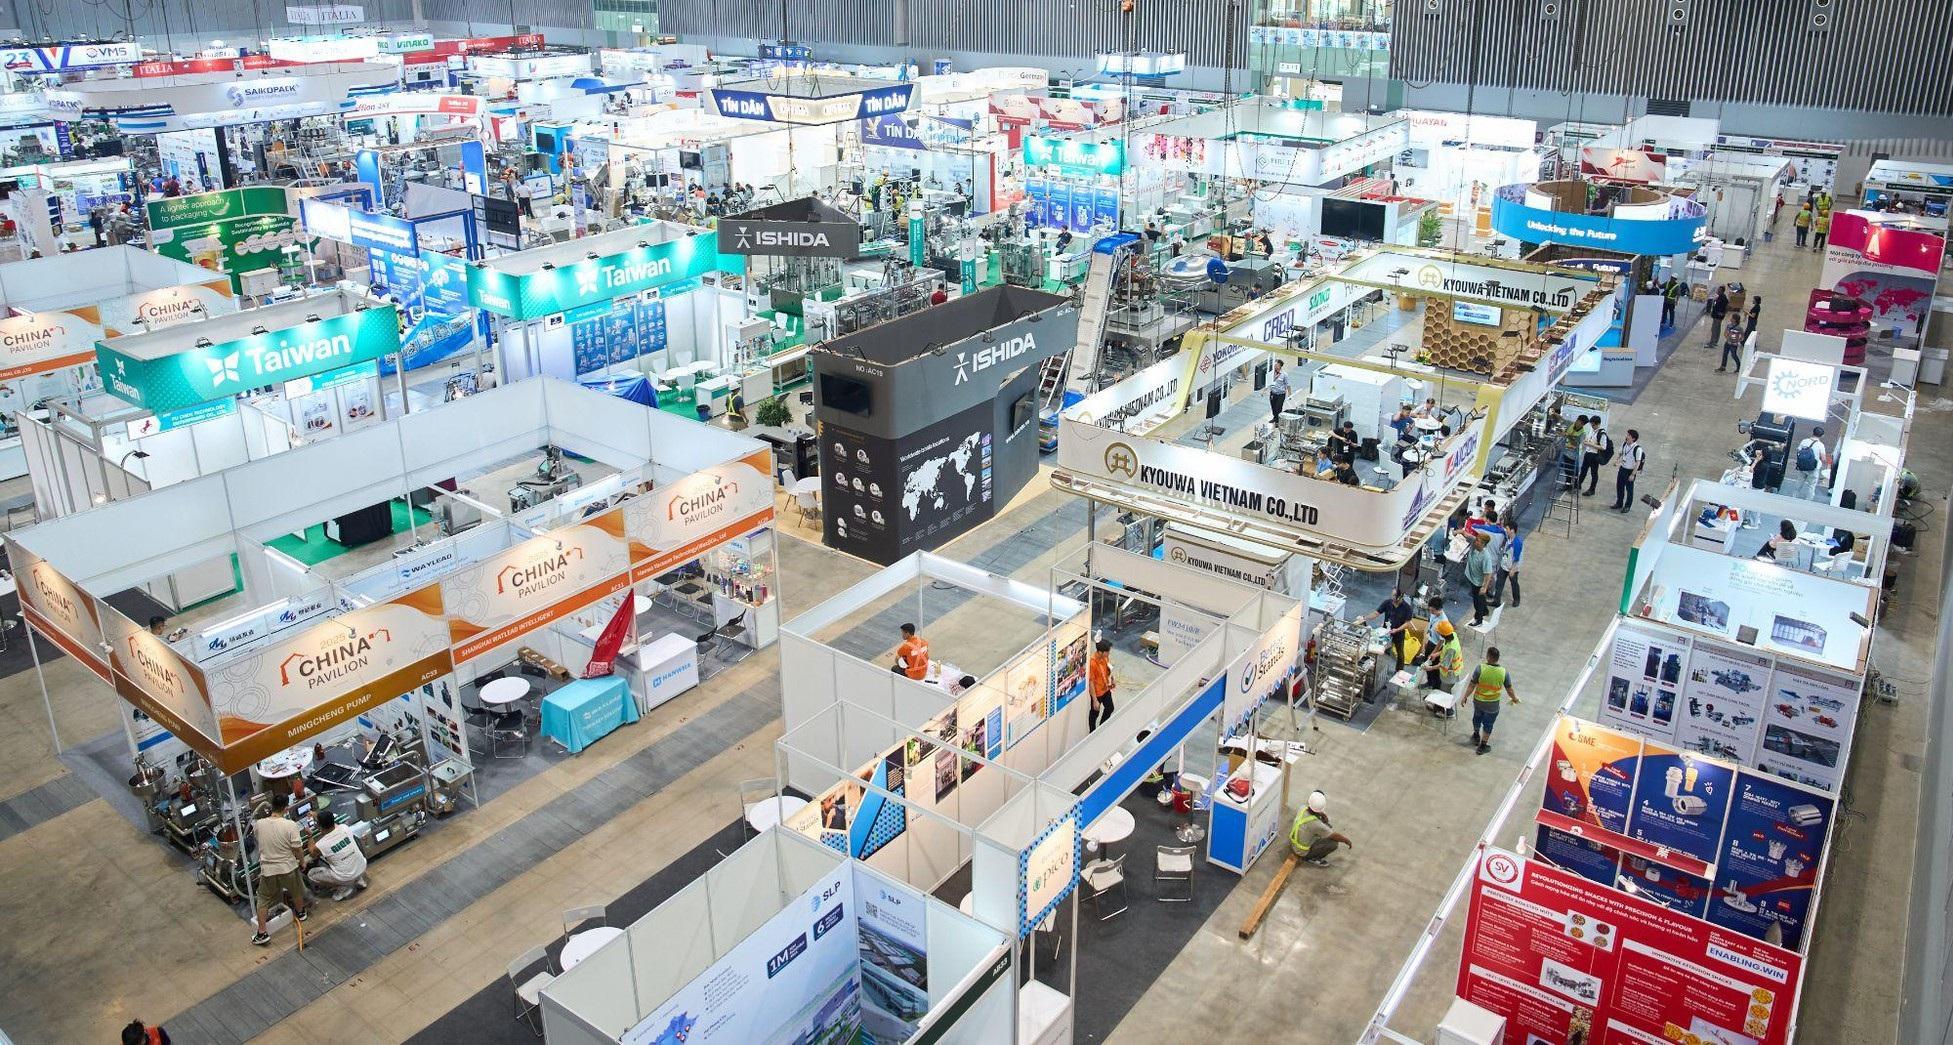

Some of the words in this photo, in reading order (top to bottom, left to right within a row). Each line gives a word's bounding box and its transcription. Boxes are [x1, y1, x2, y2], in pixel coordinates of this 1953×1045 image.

[98, 47, 127, 57] VMS
[139, 64, 173, 75] ITALIA
[244, 85, 296, 96] SAIKOPACK
[721, 97, 739, 113] TÍN
[741, 99, 764, 116] DÂN
[866, 96, 883, 112] TÍN
[885, 93, 906, 109] DÂN
[885, 122, 903, 138] TÍN
[160, 205, 166, 213] A
[167, 202, 190, 213] lighter
[191, 198, 225, 210] approach
[162, 215, 170, 223] to
[171, 209, 208, 223] packaging
[756, 231, 830, 248] ISHIDA
[1527, 220, 1567, 237] Unlocking
[1569, 227, 1585, 237] the
[1587, 229, 1617, 241] Future
[602, 255, 671, 290] Taiwan
[1443, 278, 1483, 295] KYOUWA
[150, 301, 191, 317] CHINA
[481, 290, 509, 308] Taiwan
[154, 313, 190, 324] PAVILION
[4, 329, 52, 346] CHINA
[10, 341, 51, 354] PAVILION
[245, 331, 352, 376] Taiwan
[973, 332, 1036, 372] ISHIDA
[109, 373, 140, 401] Taiwan
[1786, 376, 1829, 390] NORD
[680, 488, 726, 515] CHINA
[1141, 464, 1195, 495] KYOUWA
[1201, 479, 1262, 511] VIETNAM
[1266, 496, 1319, 526] CO.,LTD
[685, 504, 723, 526] PAVILION
[411, 553, 452, 573] WAYLEAD
[512, 554, 568, 587] CHINA
[1187, 556, 1213, 571] KYOUWA
[1214, 564, 1242, 580] VIETNAM
[1243, 573, 1266, 586] CO.,LTD
[519, 571, 565, 599] PAVILION
[40, 581, 70, 613] CHINA
[320, 633, 346, 650] 2025
[138, 650, 173, 684] CHINA
[300, 637, 371, 677] CHINA
[1257, 646, 1285, 680] Stands
[308, 656, 368, 689] PAVILION
[143, 669, 175, 697] PAVILION
[287, 706, 345, 737] MINGCHENG
[346, 693, 372, 711] PUMP
[1577, 735, 1597, 747] SME
[1495, 861, 1509, 873] SV
[823, 882, 841, 902] SLP
[1531, 872, 1584, 894] REVOLUTIONIZING
[1585, 889, 1608, 903] SNACKS
[1608, 898, 1625, 909] WITH
[1625, 904, 1658, 921] PRECISION
[1664, 917, 1693, 934] FLAVOUR
[817, 922, 825, 934] 6
[769, 948, 789, 971] 1M
[1709, 947, 1784, 980] ENABLING.WIN
